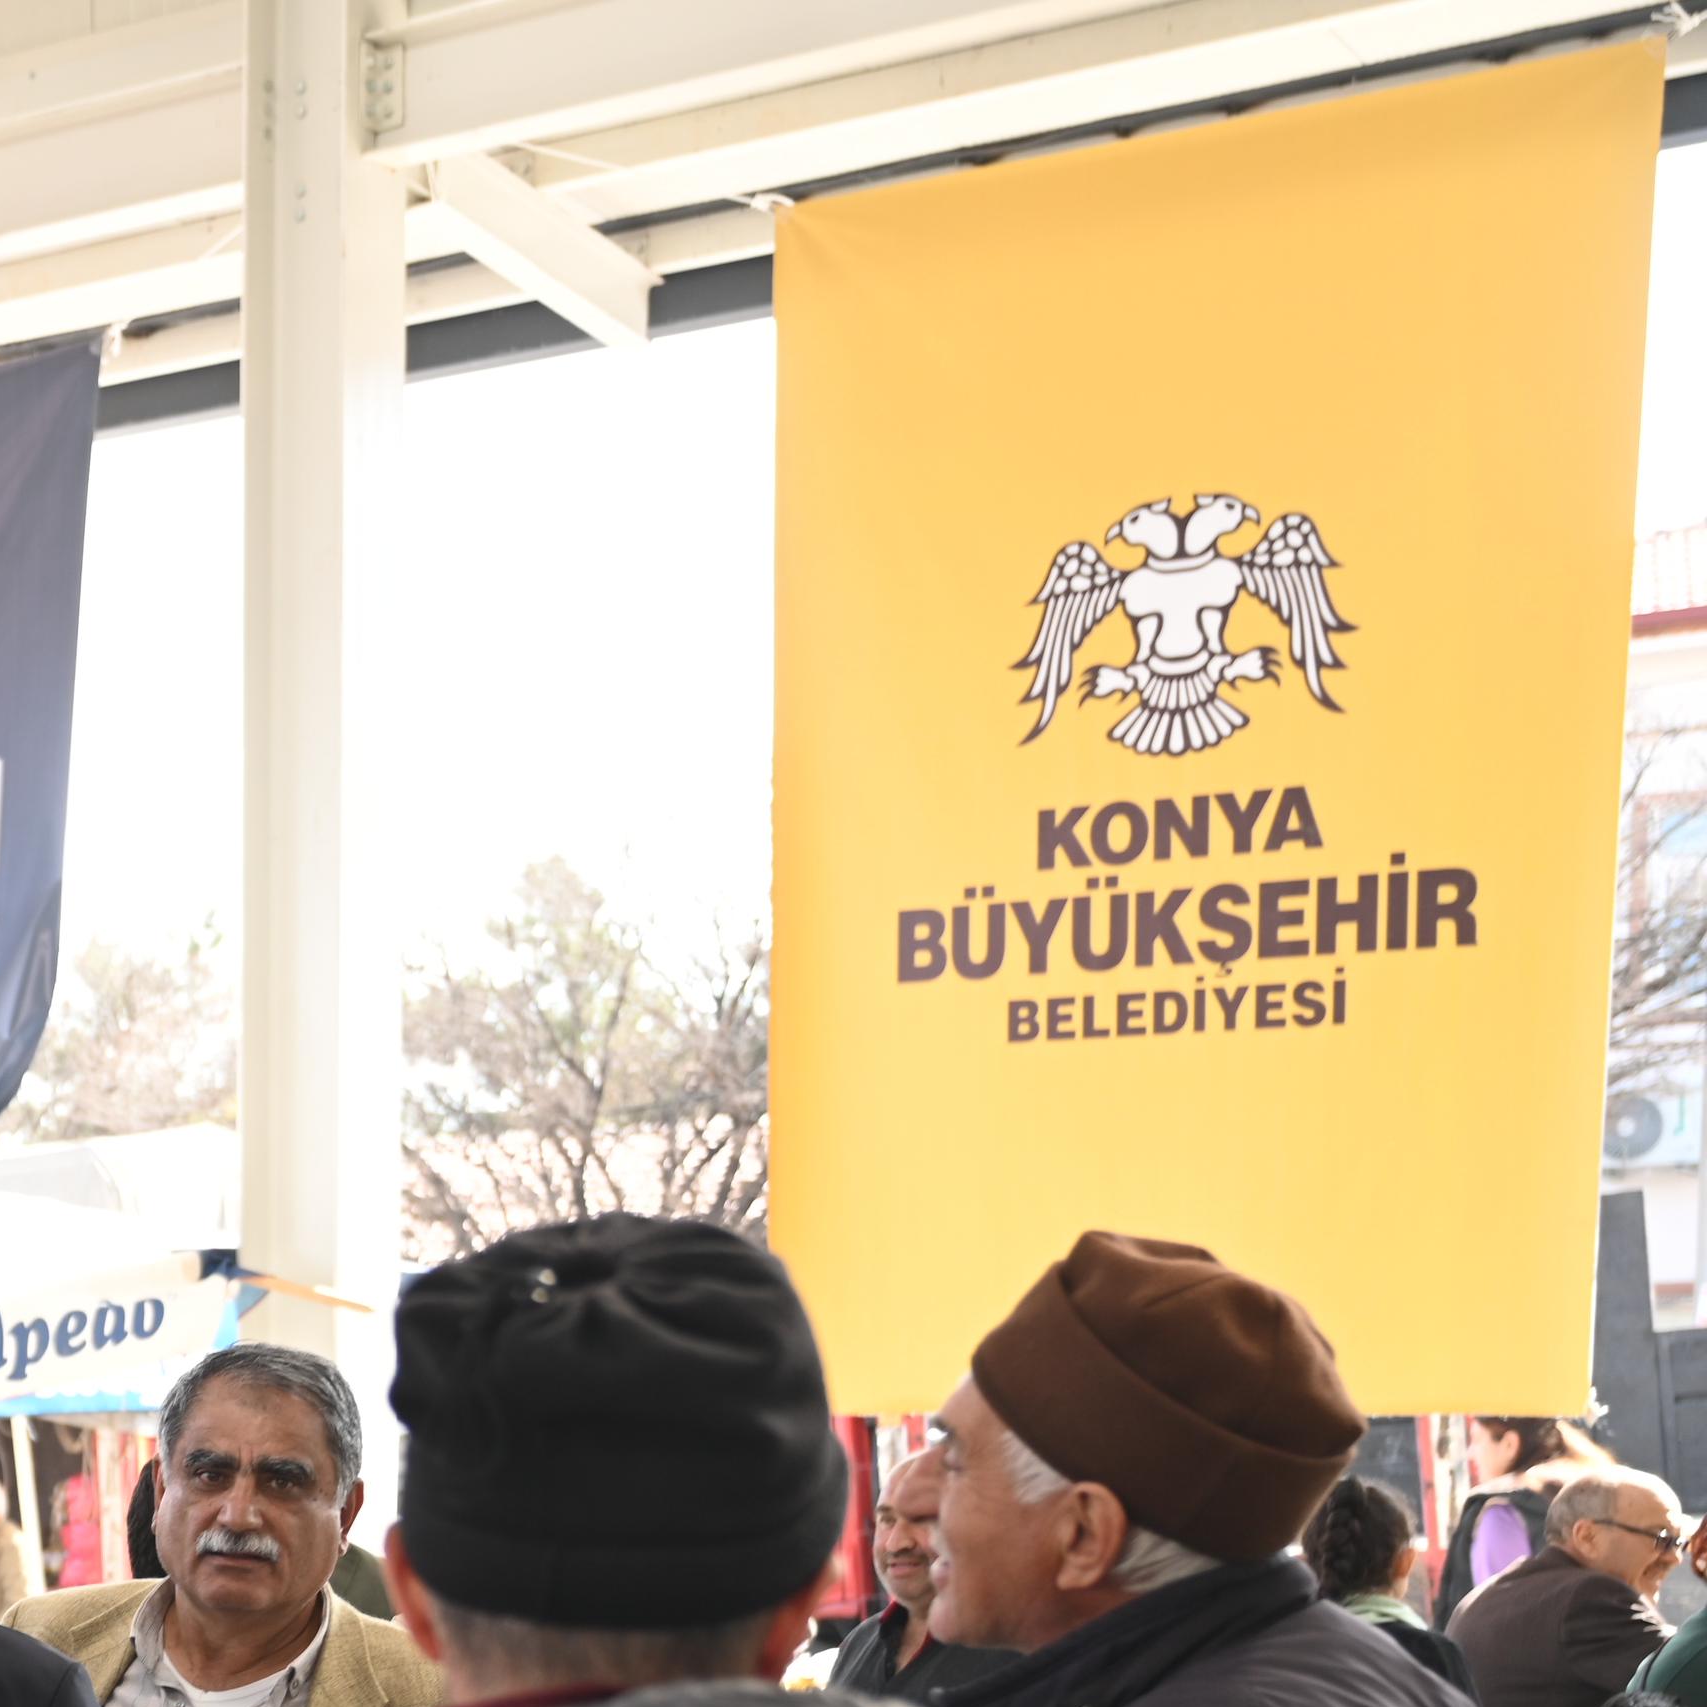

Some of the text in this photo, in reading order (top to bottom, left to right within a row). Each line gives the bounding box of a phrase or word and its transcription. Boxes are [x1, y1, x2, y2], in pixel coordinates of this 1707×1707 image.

[1037, 785, 1323, 871] KONYA
[898, 852, 1478, 984] BÜYÜKŞEHİR
[1008, 967, 1347, 1043] BELEDİYESİ
